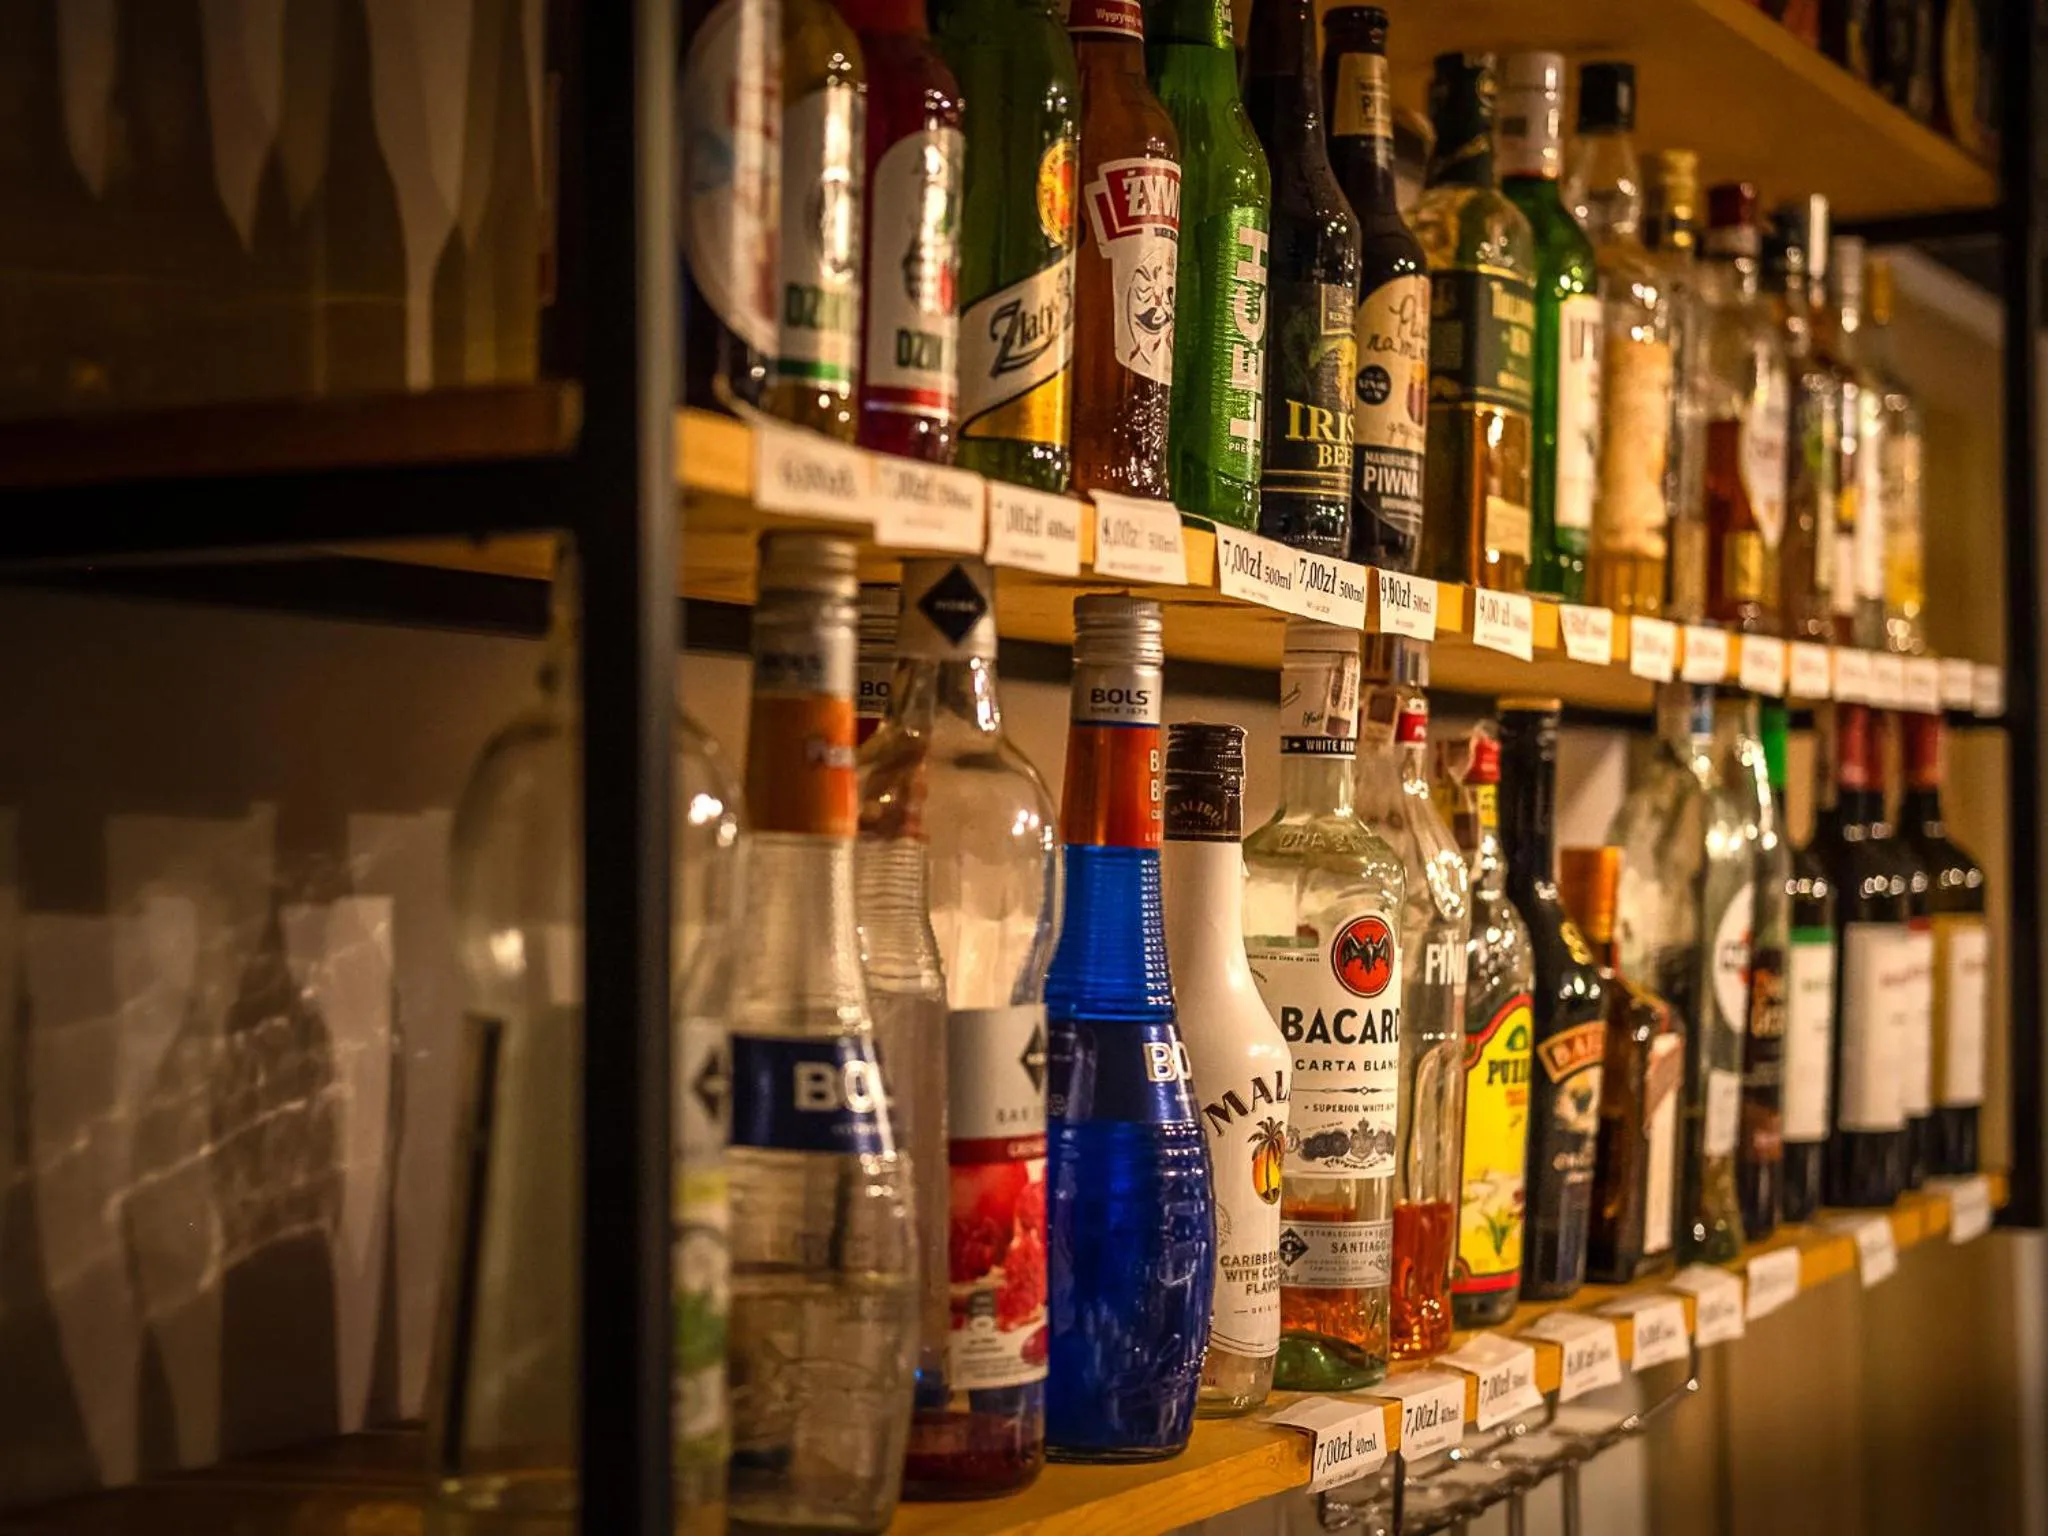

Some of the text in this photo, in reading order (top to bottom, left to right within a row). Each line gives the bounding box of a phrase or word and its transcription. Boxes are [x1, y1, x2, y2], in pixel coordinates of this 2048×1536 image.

[1229, 226, 1269, 442] LECH
[1223, 539, 1292, 591] 7,00zł 500ml
[1299, 557, 1337, 596] 7,00zł
[1339, 581, 1365, 603] 500ml
[1091, 688, 1149, 705] BOLS
[1306, 739, 1338, 751] WHITE
[1295, 1059, 1356, 1072] CARTA
[1312, 1103, 1360, 1113] SUPERIOR
[1225, 1269, 1259, 1282] WITH
[1405, 1400, 1438, 1439] 7,00zł
[1316, 1431, 1377, 1474] 7,00zł 40ml
